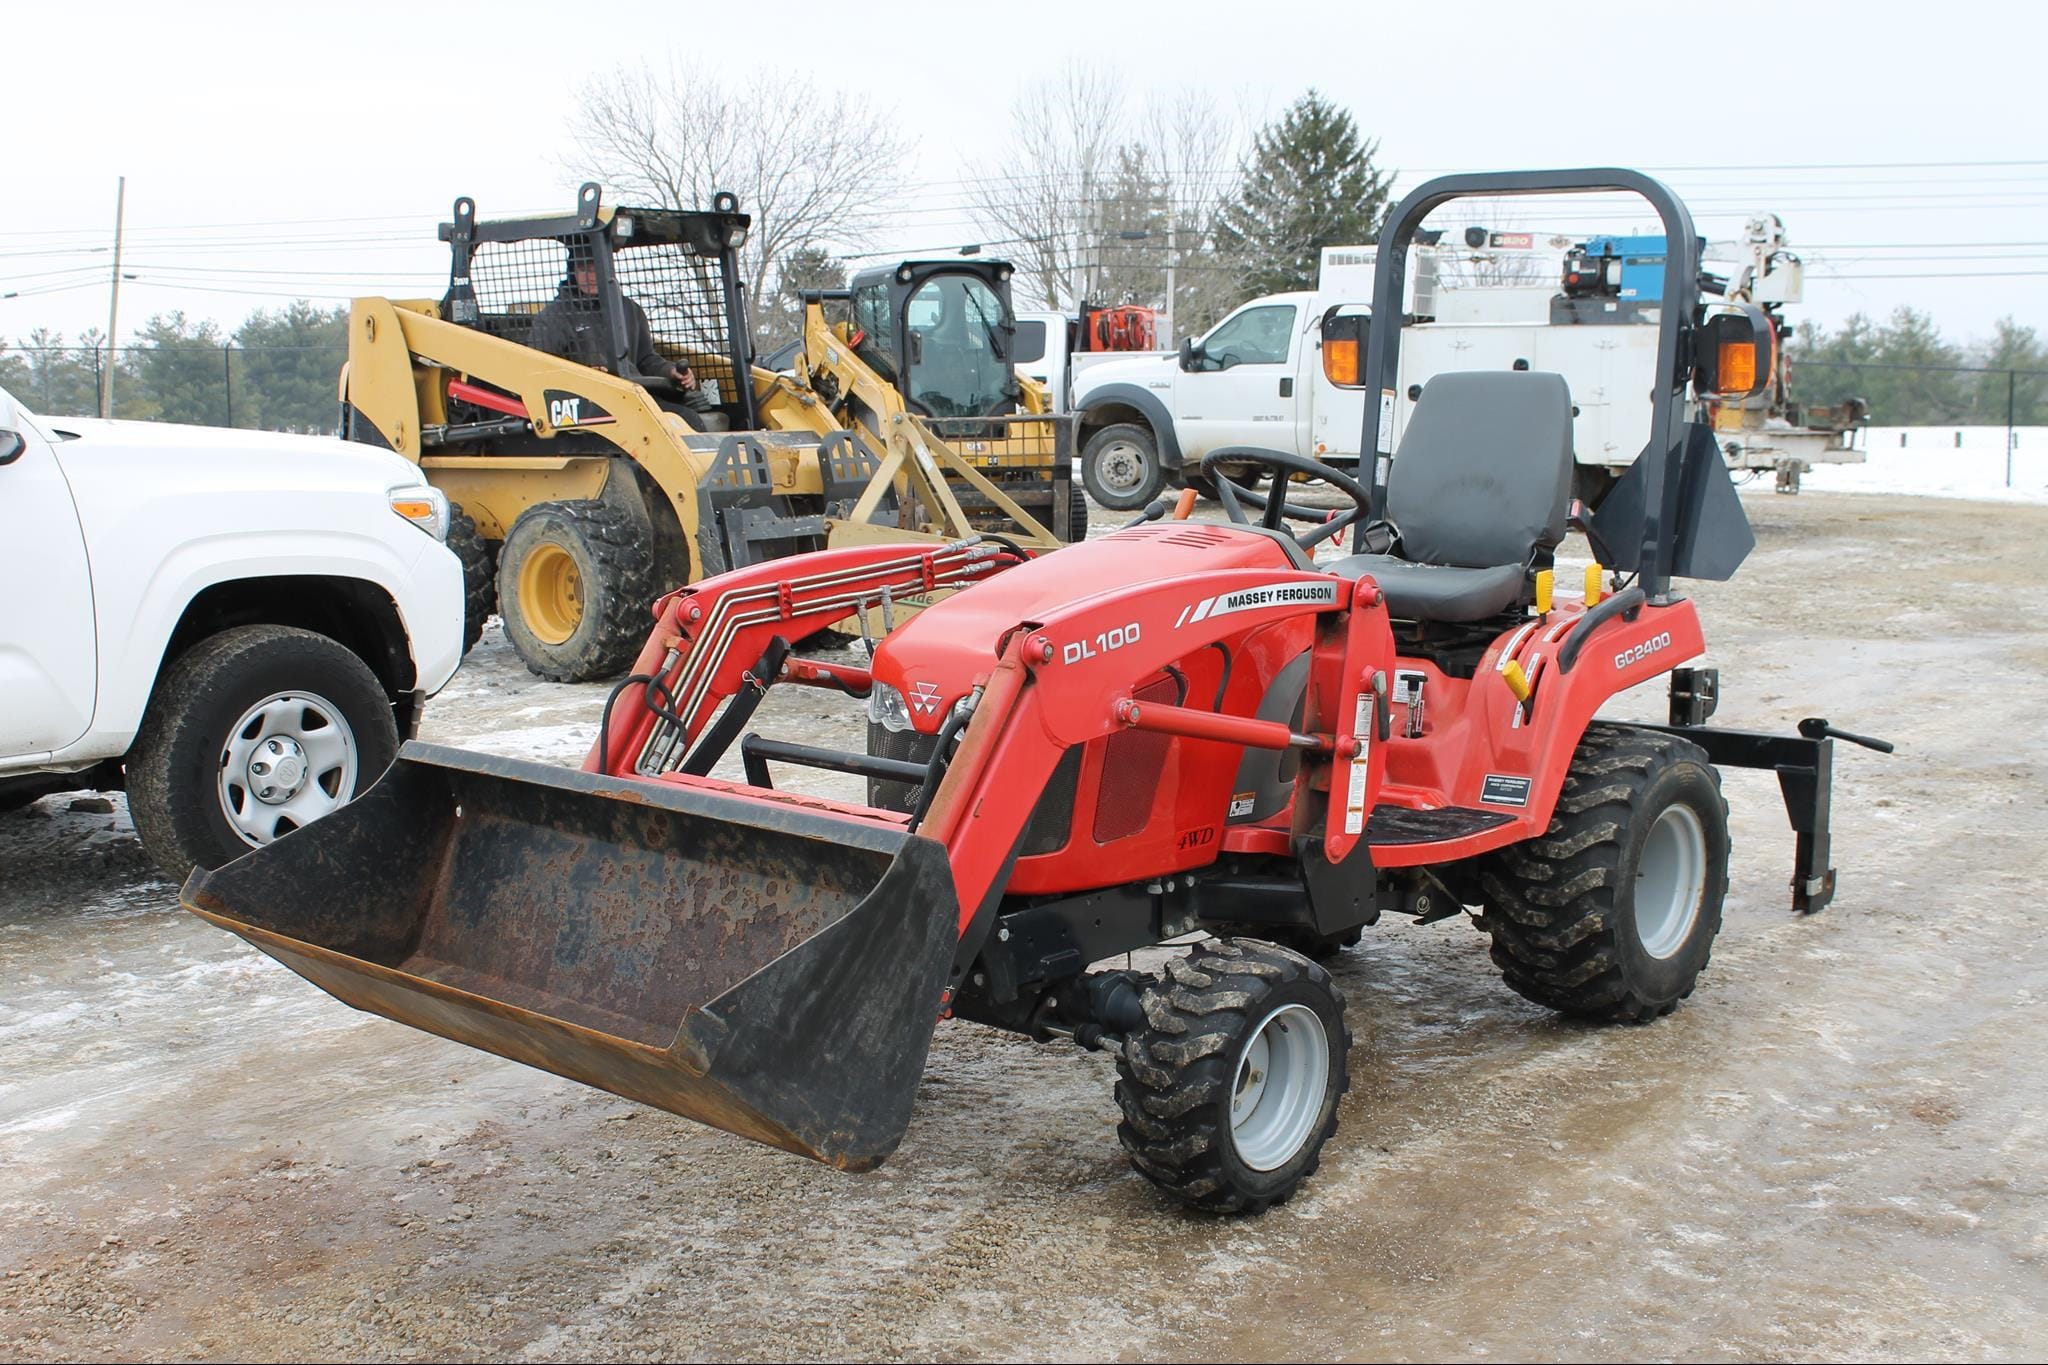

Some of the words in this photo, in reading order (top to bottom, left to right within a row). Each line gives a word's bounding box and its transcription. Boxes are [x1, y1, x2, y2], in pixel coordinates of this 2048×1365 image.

[551, 398, 580, 427] CAT
[1227, 590, 1274, 609] MASSEY
[1276, 587, 1332, 601] FERGUSON
[1614, 631, 1672, 670] GC2400
[1177, 827, 1215, 850] 4WD
